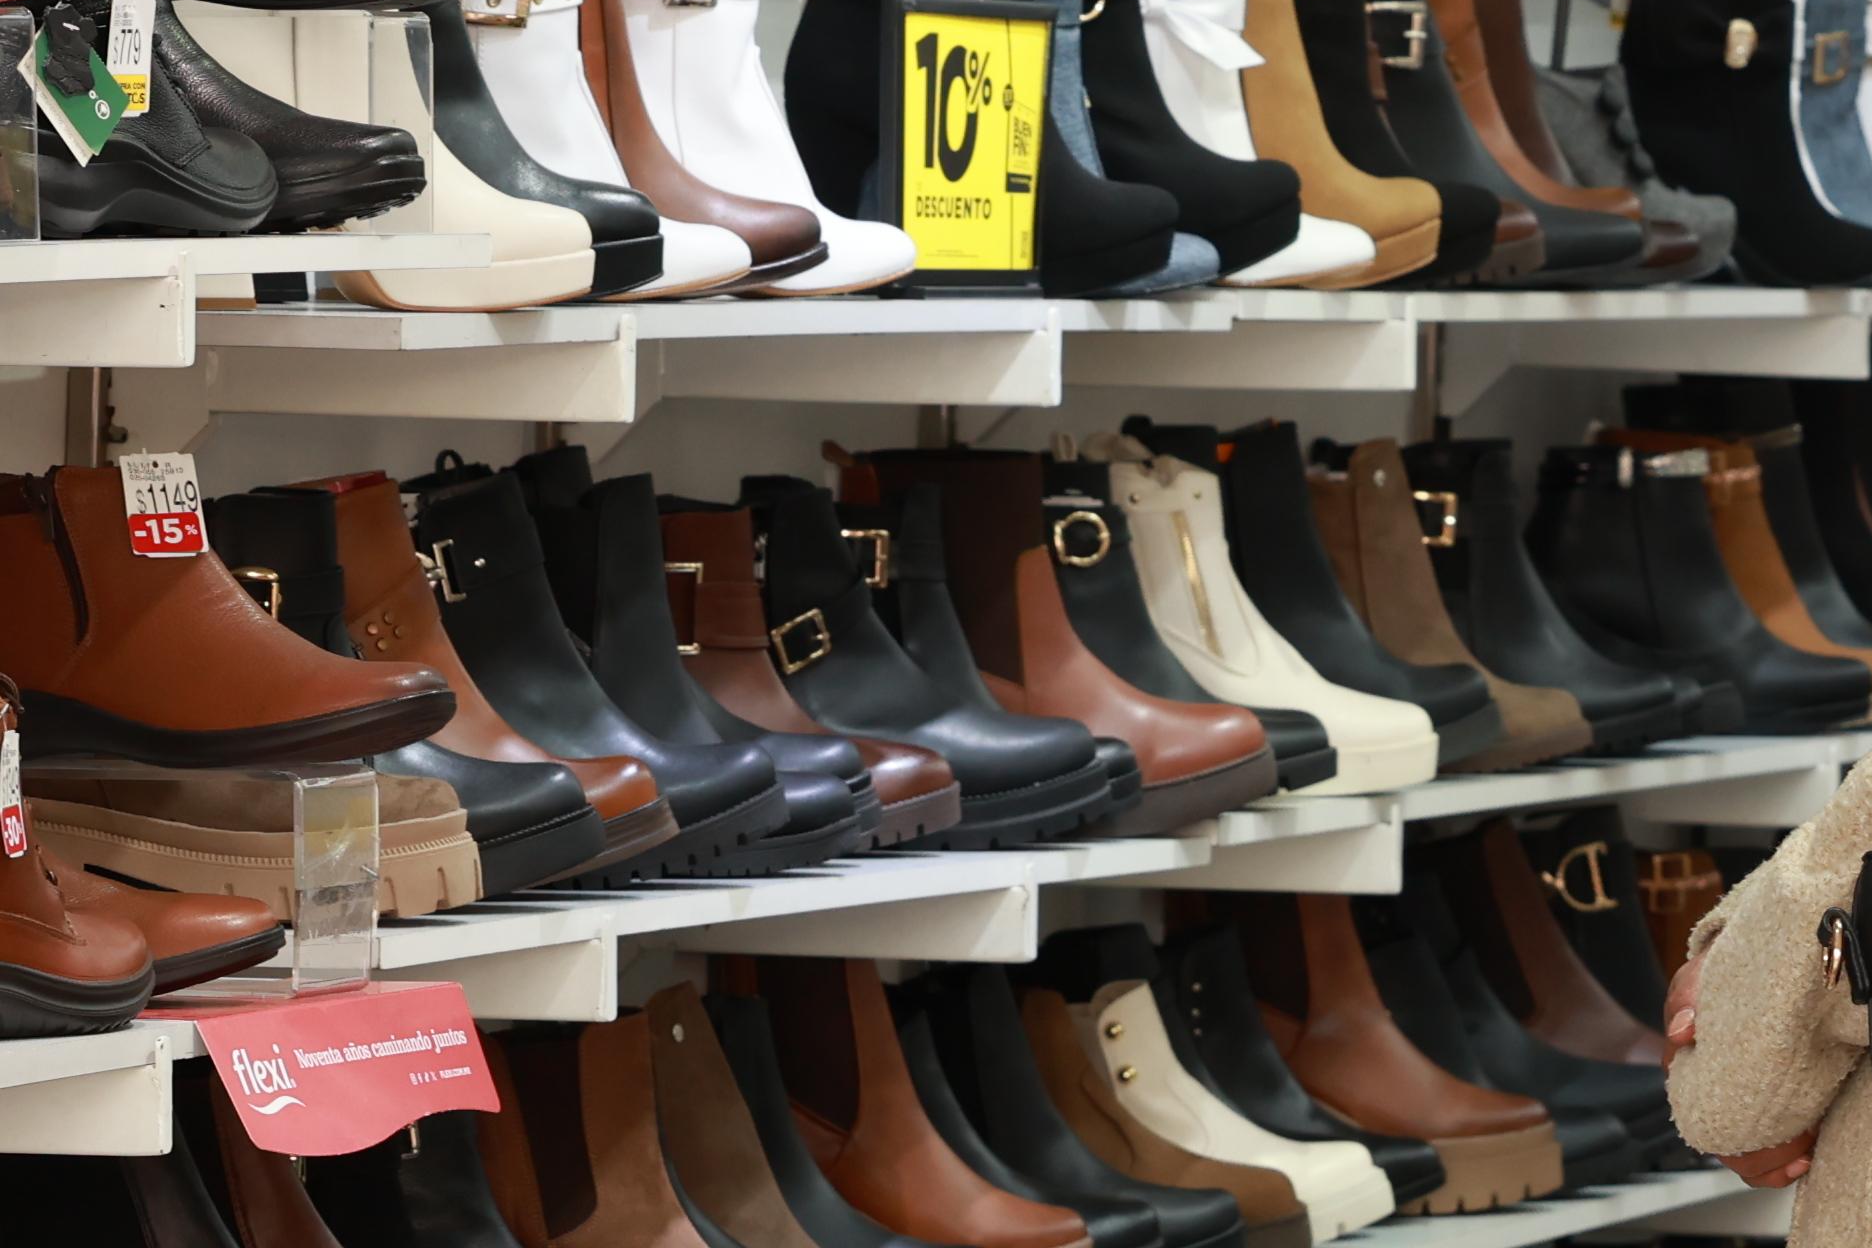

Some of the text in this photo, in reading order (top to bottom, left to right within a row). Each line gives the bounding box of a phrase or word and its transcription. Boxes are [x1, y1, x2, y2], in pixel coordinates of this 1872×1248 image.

[113, 28, 142, 66] $779
[132, 81, 146, 90] CON
[915, 32, 992, 183] 10%
[916, 195, 993, 220] DESCUENTO
[135, 479, 199, 514] $1149
[133, 517, 199, 545] -15%
[231, 1028, 469, 1096] flexi Noventa años caminando juntos
